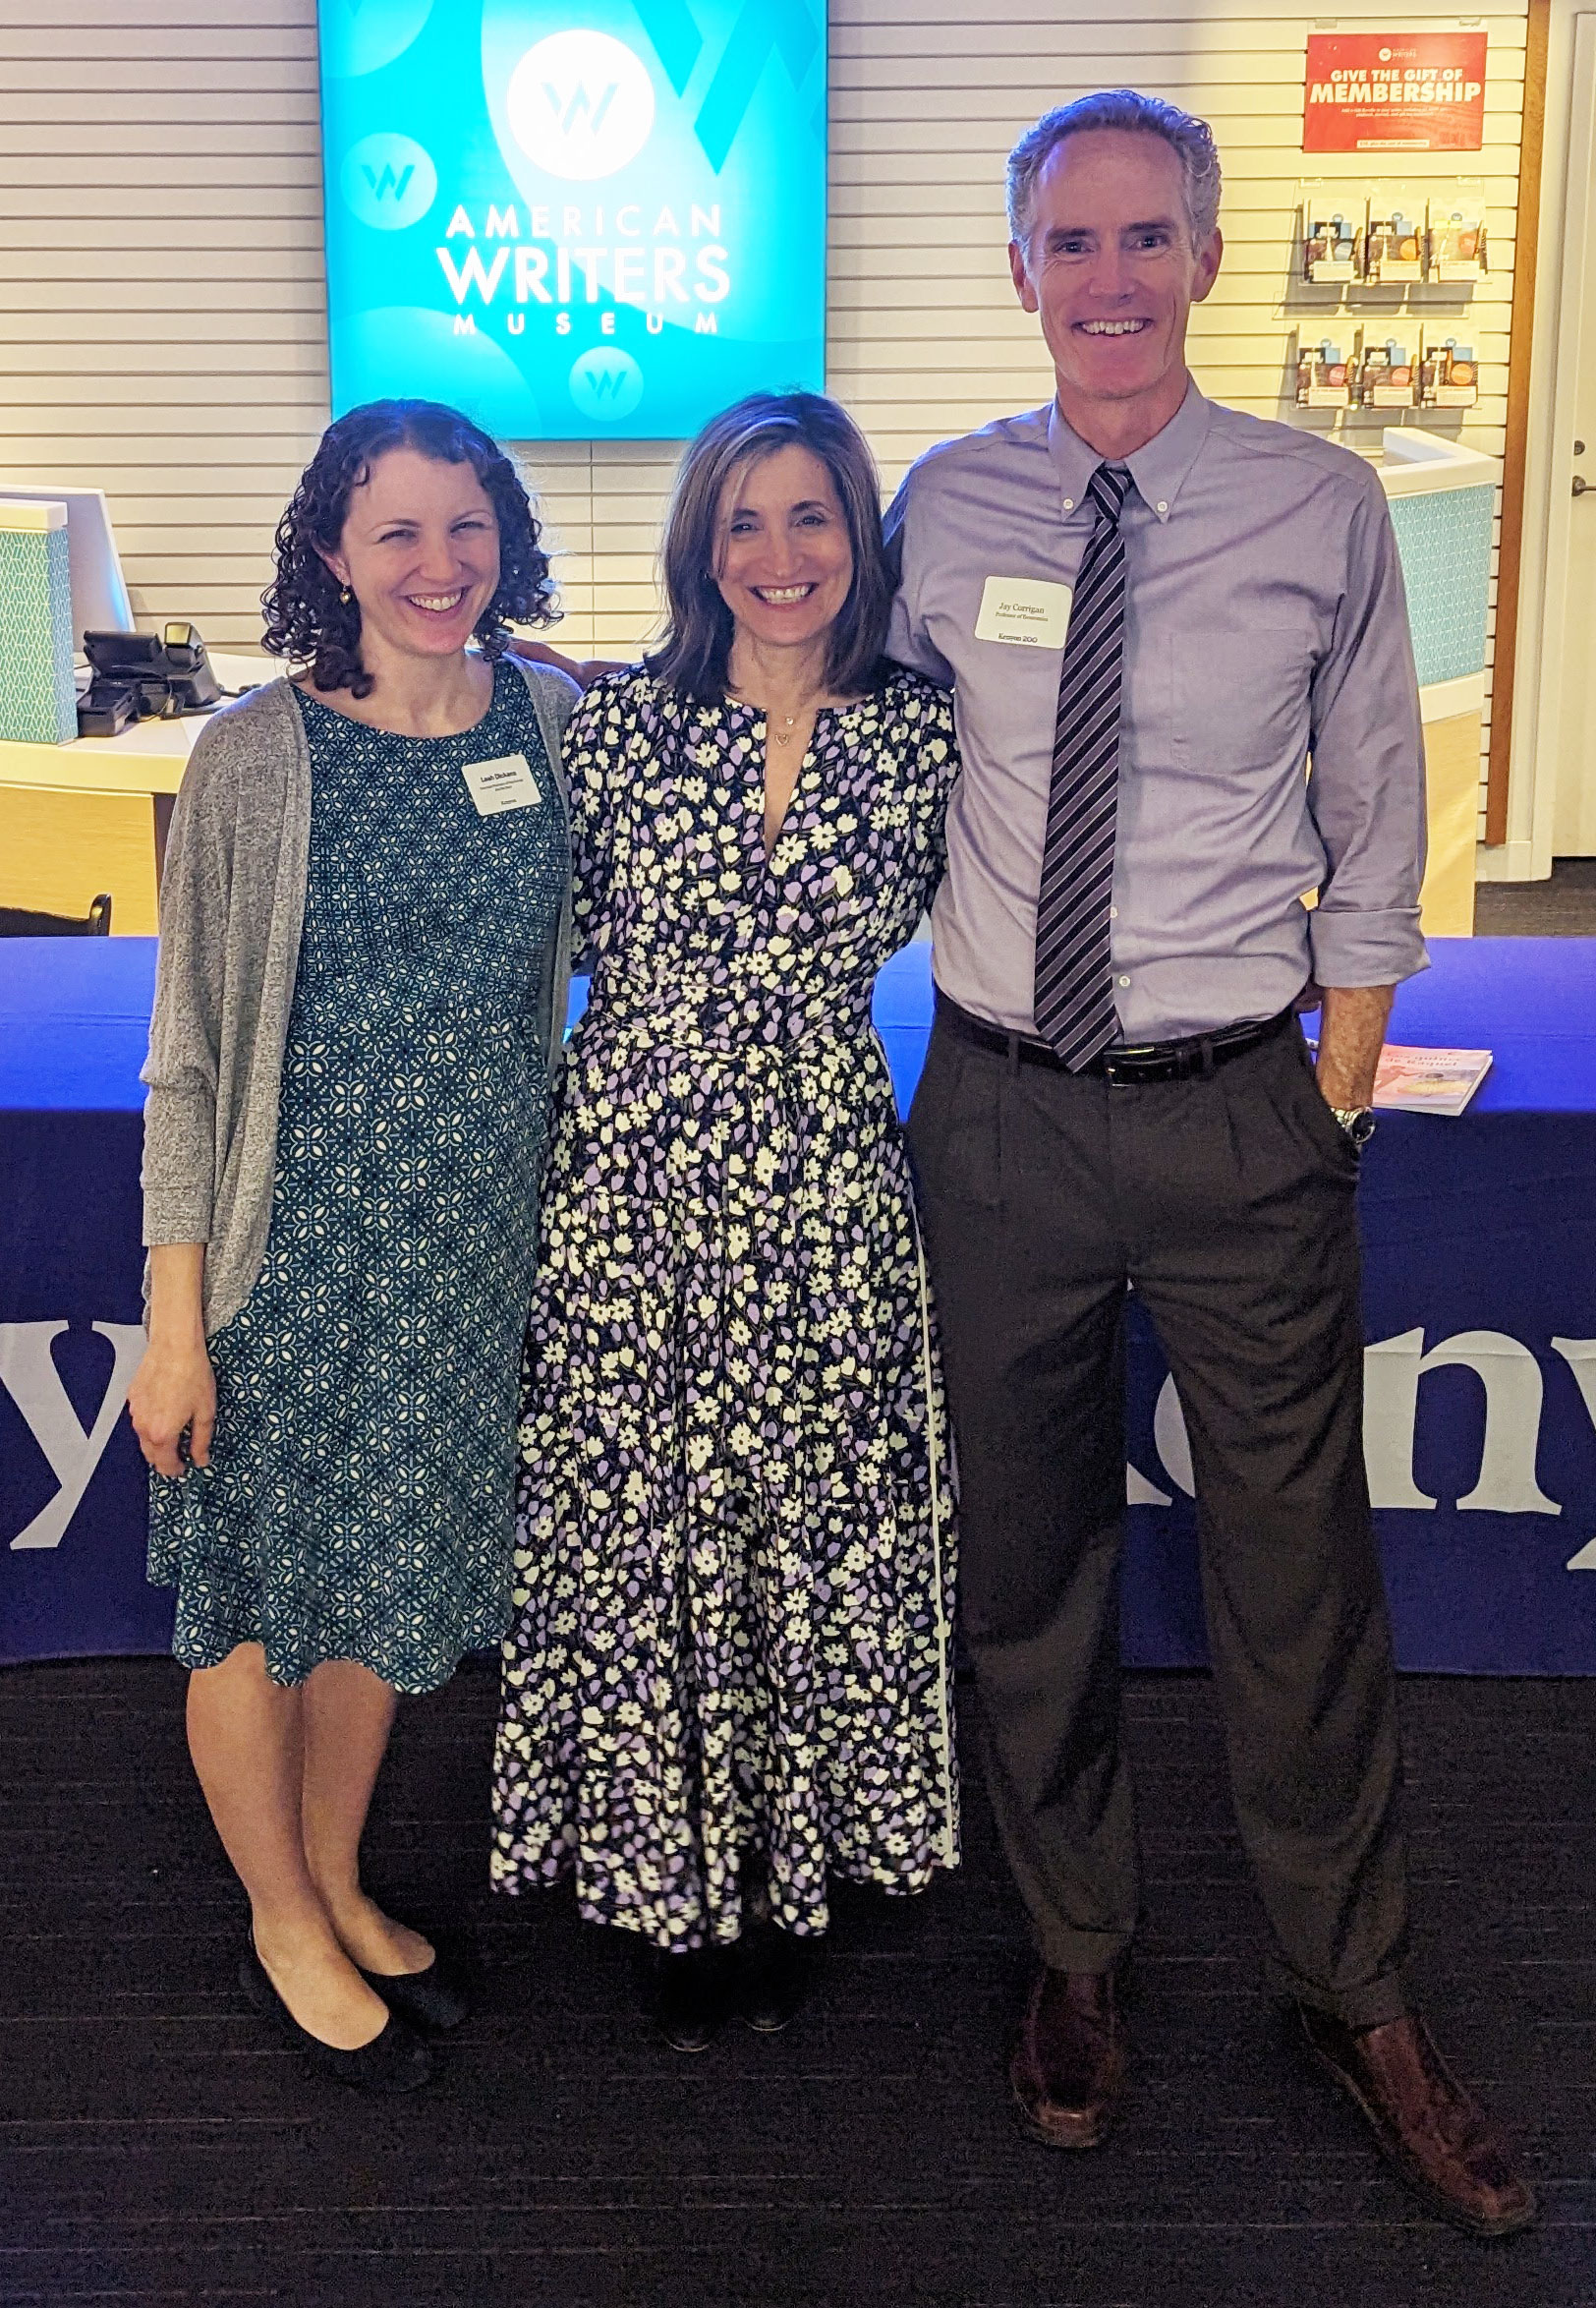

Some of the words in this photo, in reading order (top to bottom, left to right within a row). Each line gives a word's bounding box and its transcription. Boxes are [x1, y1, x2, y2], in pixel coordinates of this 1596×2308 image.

[1331, 70, 1367, 83] GIVE
[1371, 69, 1399, 82] THE
[1403, 69, 1439, 82] GIFT
[1442, 68, 1463, 81] OF
[1309, 82, 1481, 103] MEMBERSHIP
[445, 203, 720, 239] AMERICAN
[435, 245, 731, 306] WRITERS
[453, 312, 718, 335] MUSEUM
[998, 603, 1011, 611] Jay
[1012, 604, 1045, 613] Corrigan
